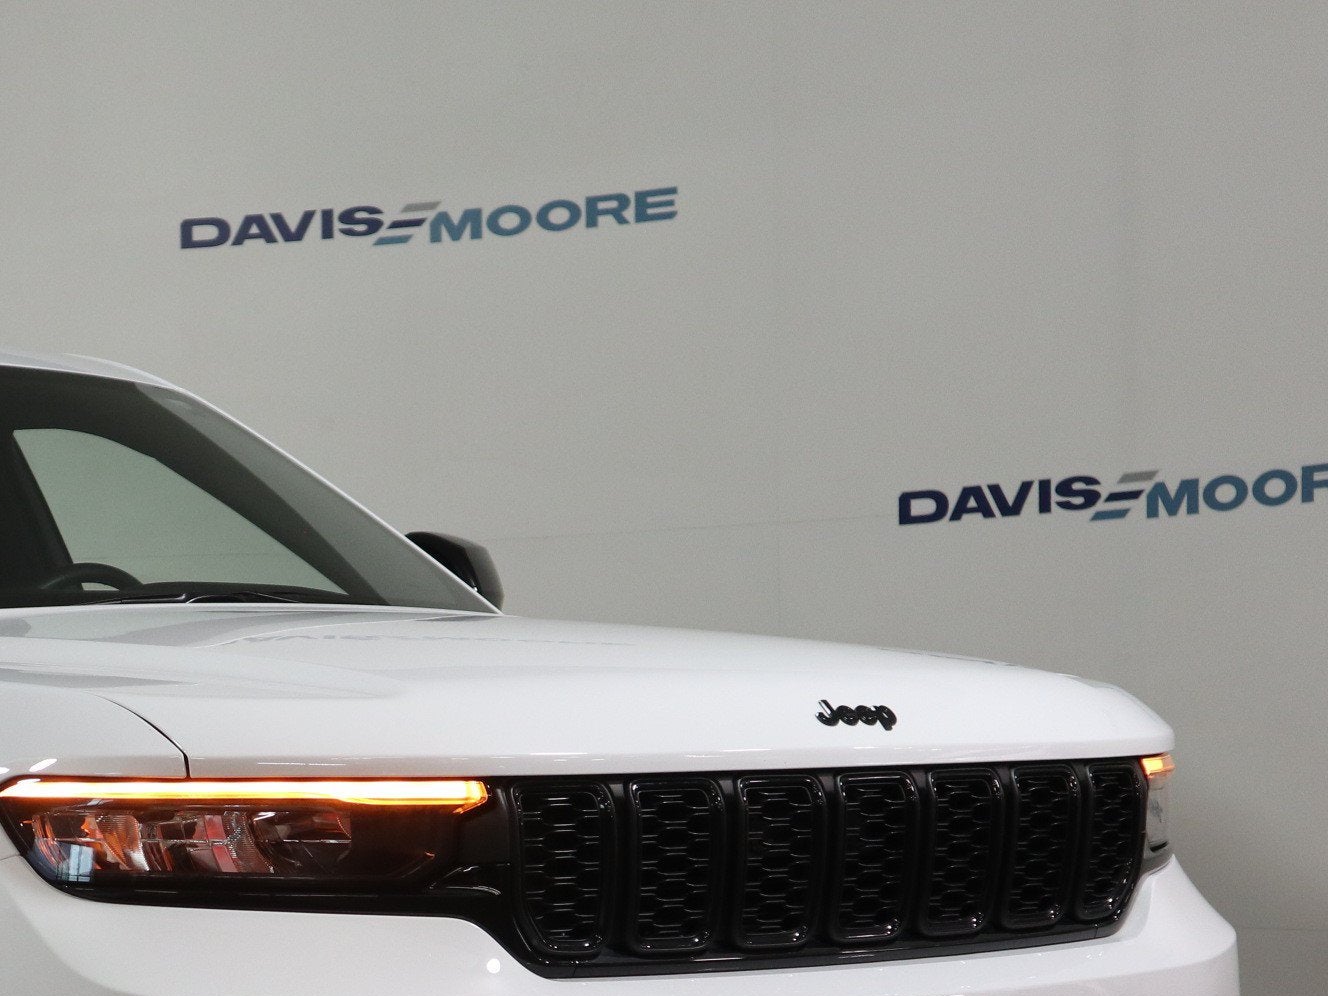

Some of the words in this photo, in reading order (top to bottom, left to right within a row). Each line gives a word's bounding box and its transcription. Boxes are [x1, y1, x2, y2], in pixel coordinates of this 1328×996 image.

[179, 205, 384, 249] DAVIS
[429, 187, 679, 243] MOORE
[898, 475, 1102, 525] DAVIS
[815, 699, 898, 731] Jeep
